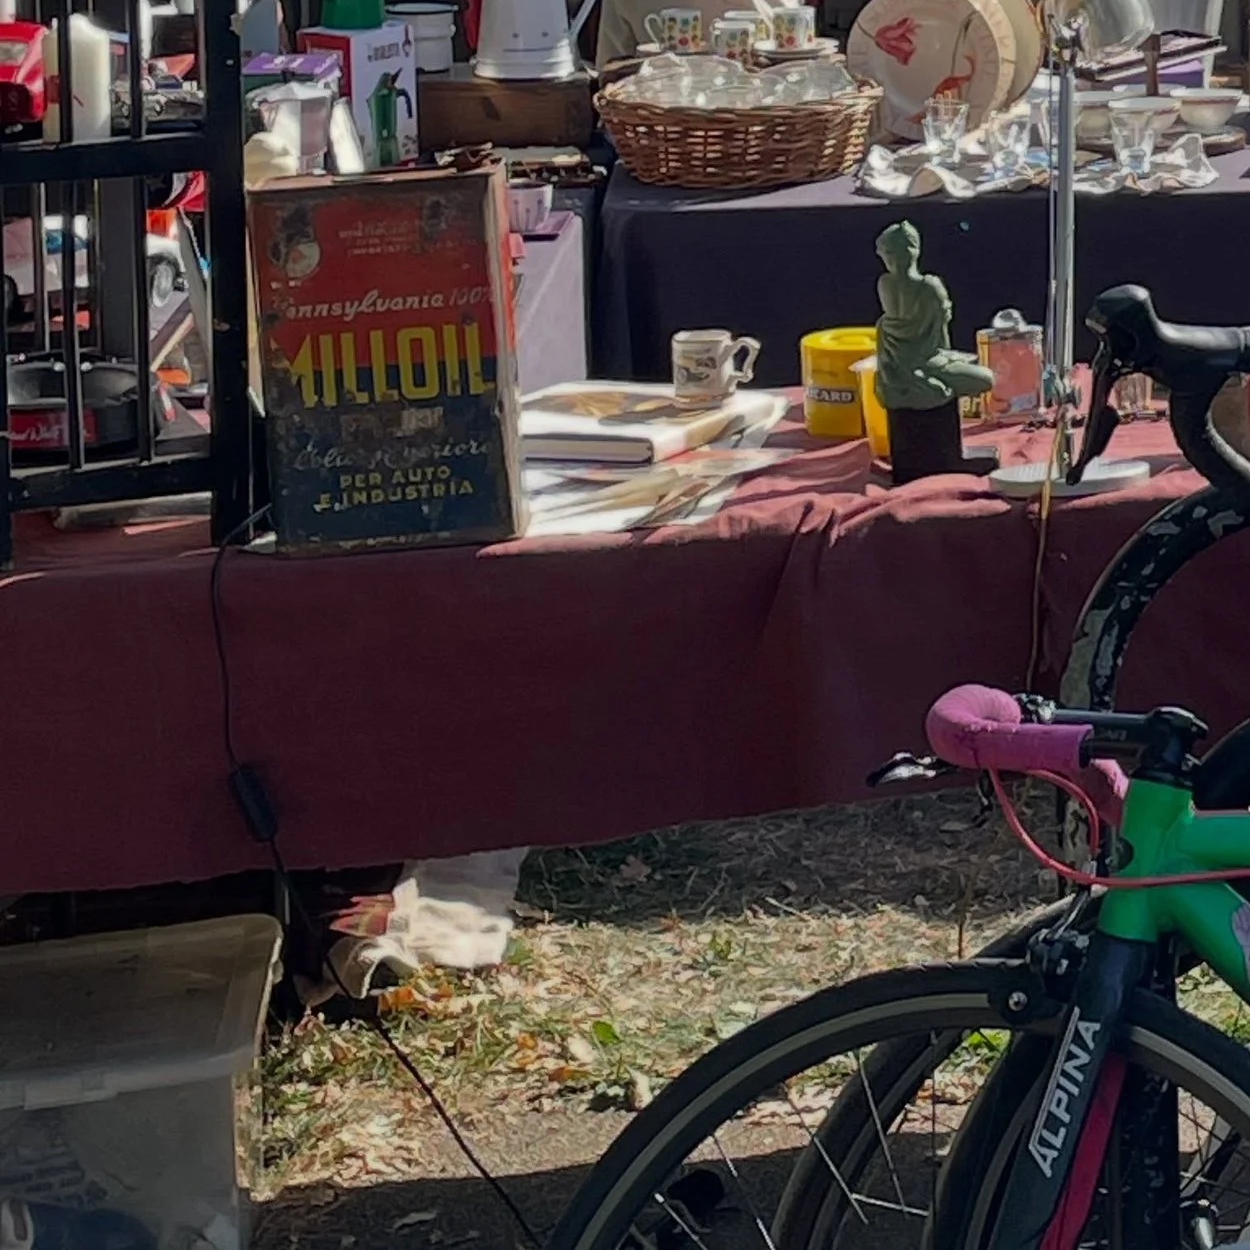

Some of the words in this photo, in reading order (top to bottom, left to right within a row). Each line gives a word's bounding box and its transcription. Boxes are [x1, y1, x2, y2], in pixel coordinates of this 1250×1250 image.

[339, 473, 383, 490] PER
[390, 465, 451, 485] AUTO
[339, 479, 474, 508] INDUSTRIA
[1029, 1012, 1101, 1178] ALPINA
